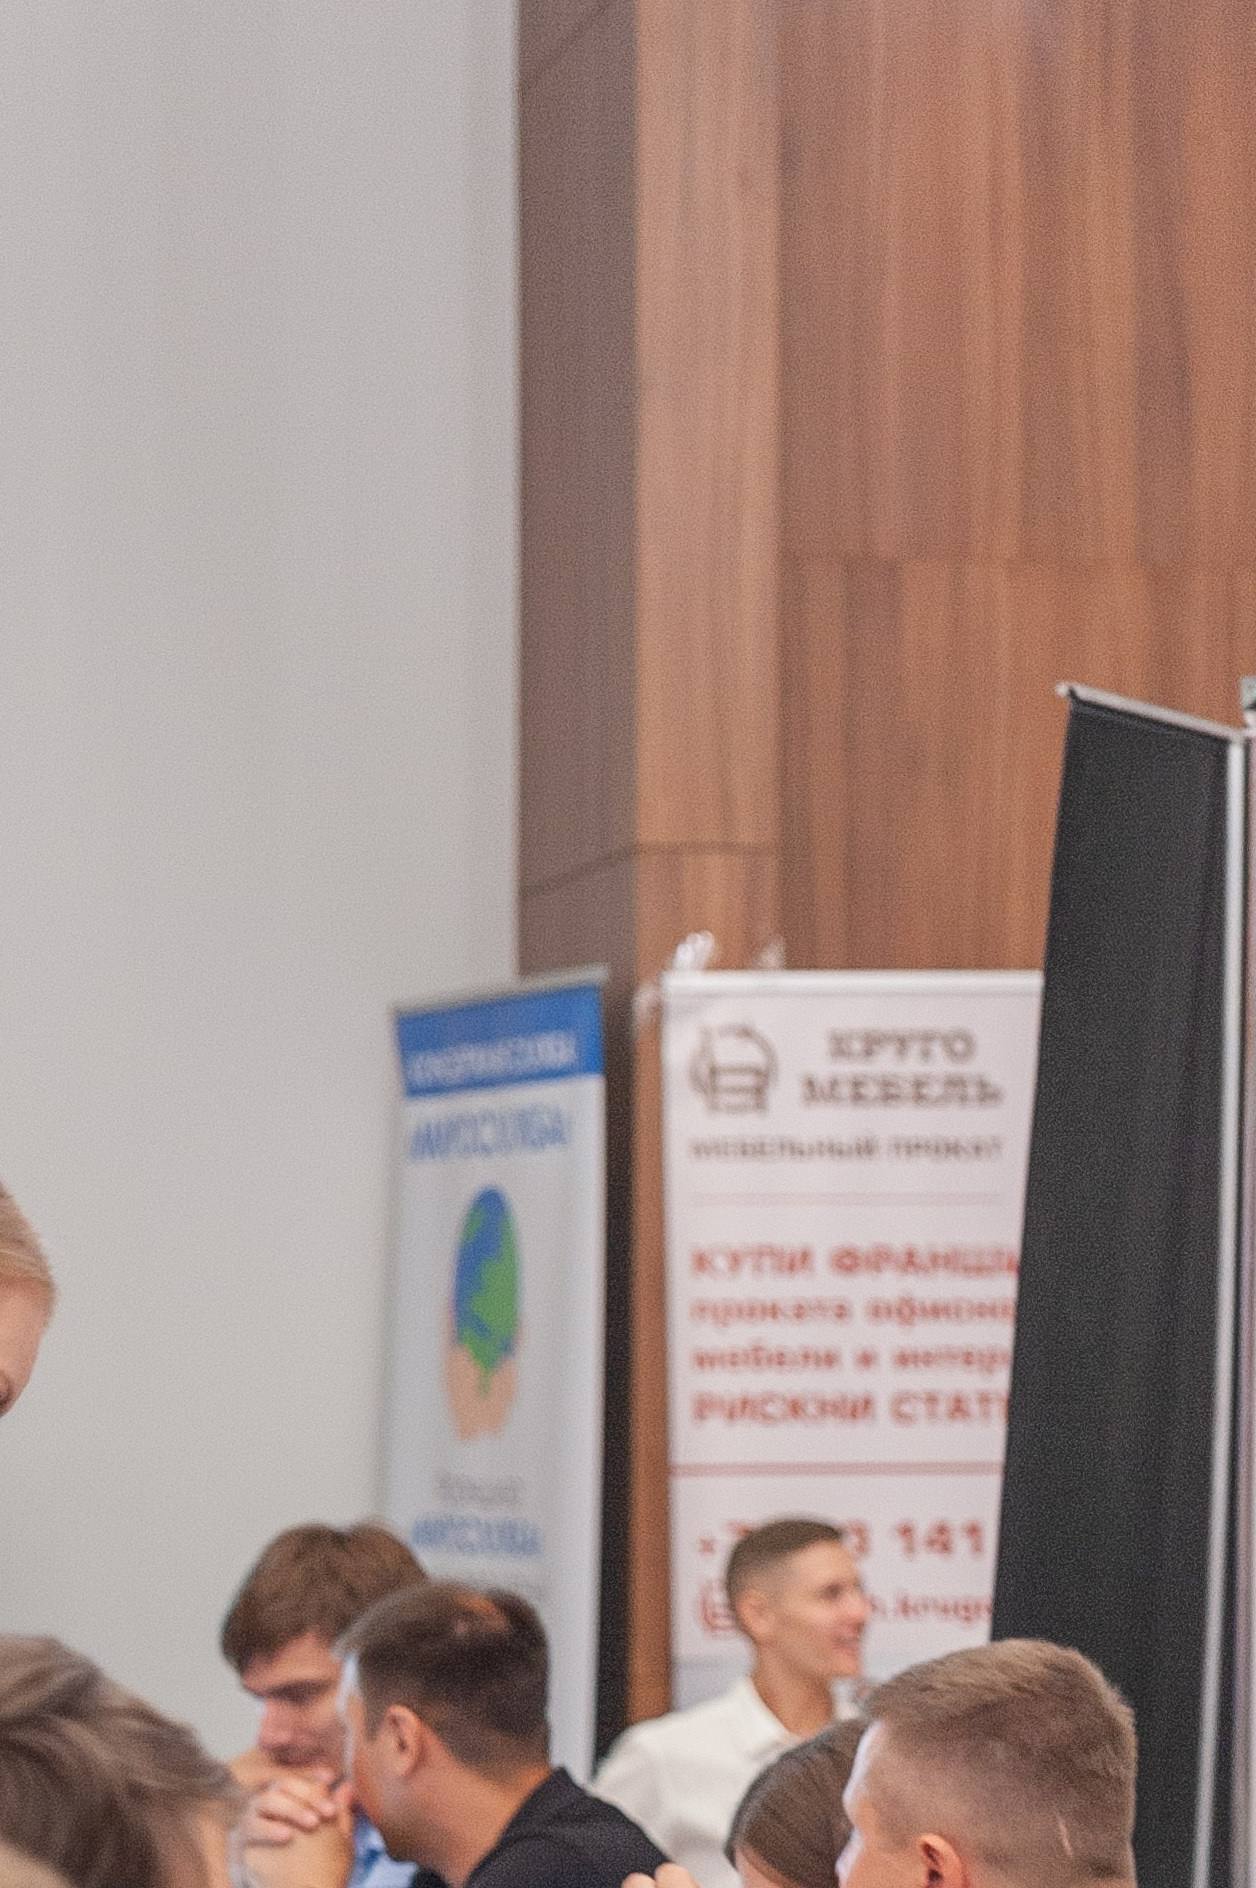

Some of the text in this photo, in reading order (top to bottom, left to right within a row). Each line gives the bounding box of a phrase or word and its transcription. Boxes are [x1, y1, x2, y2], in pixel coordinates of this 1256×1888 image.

[801, 1073, 1005, 1108] МЕБЕЛЬ
[692, 1247, 812, 1275] КУПИ
[891, 1393, 1007, 1424] СТАТ
[895, 1520, 984, 1558] 141
